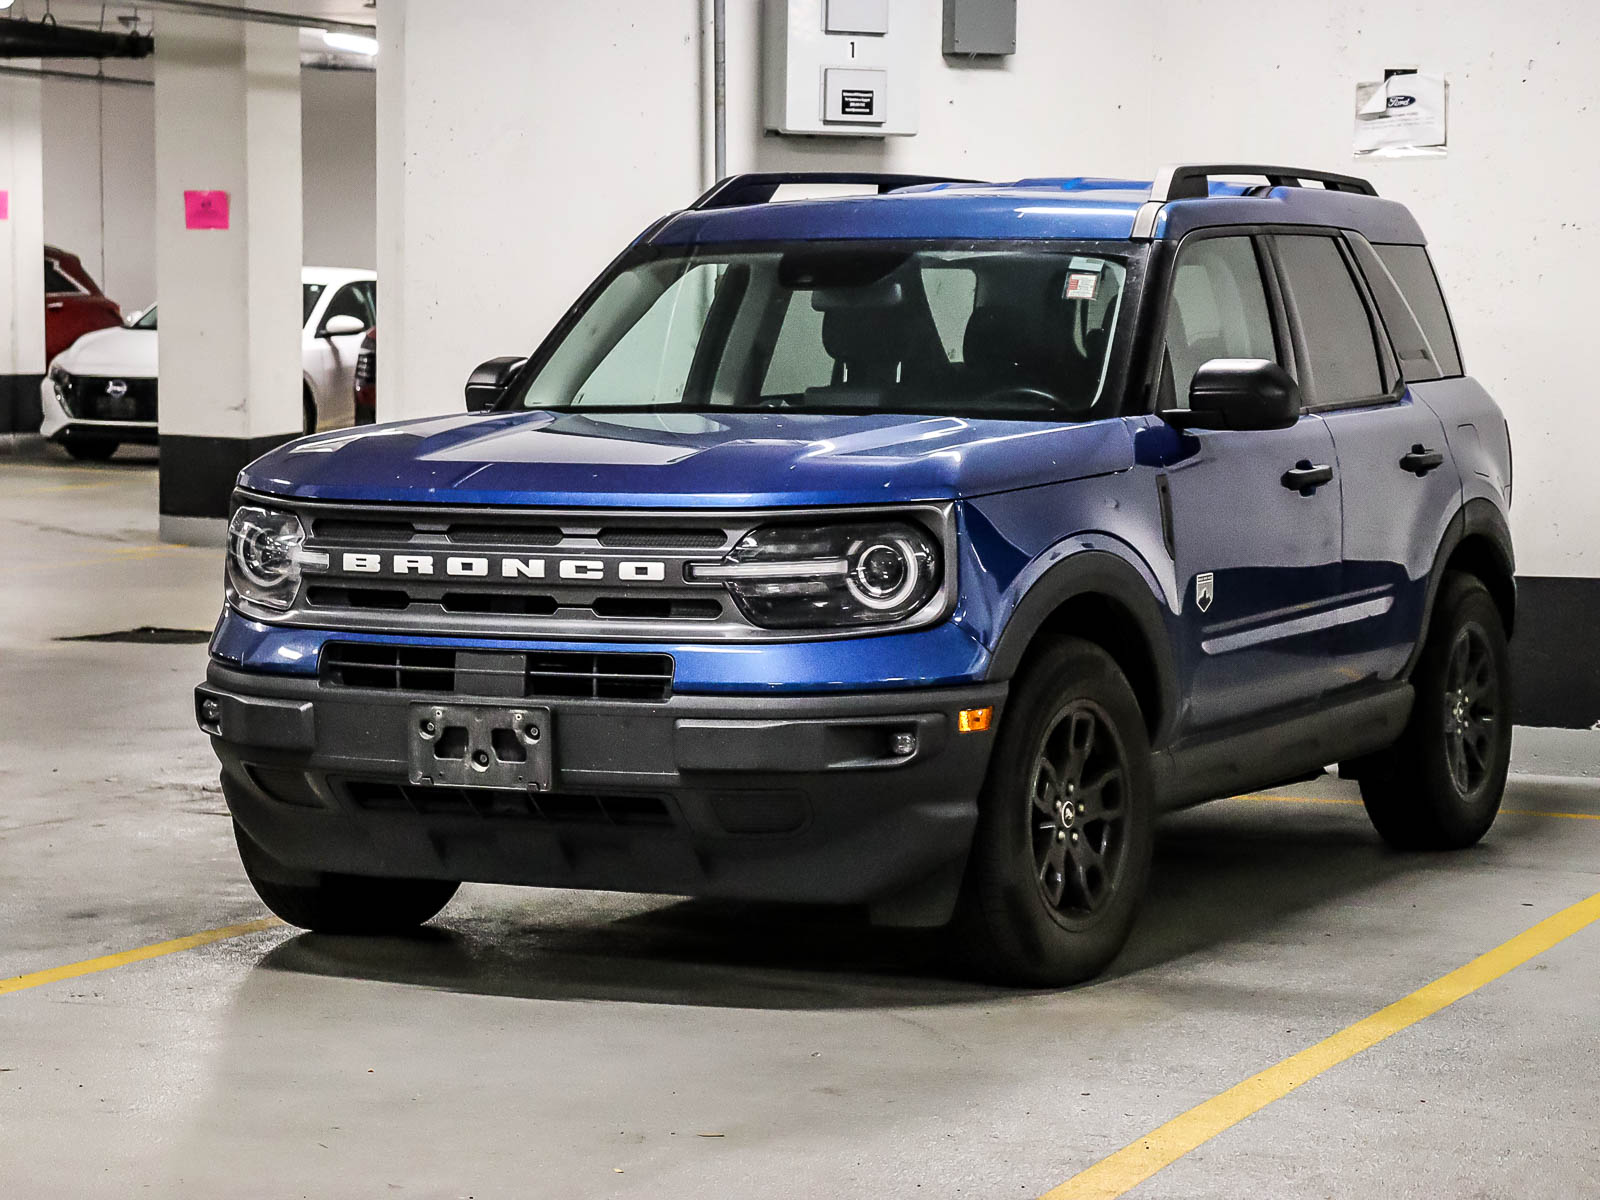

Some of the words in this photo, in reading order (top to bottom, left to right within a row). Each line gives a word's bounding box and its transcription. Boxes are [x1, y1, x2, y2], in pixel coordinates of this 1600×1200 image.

[850, 41, 855, 58] 1
[1387, 96, 1410, 107] Ford
[342, 552, 665, 581] BRONCO
